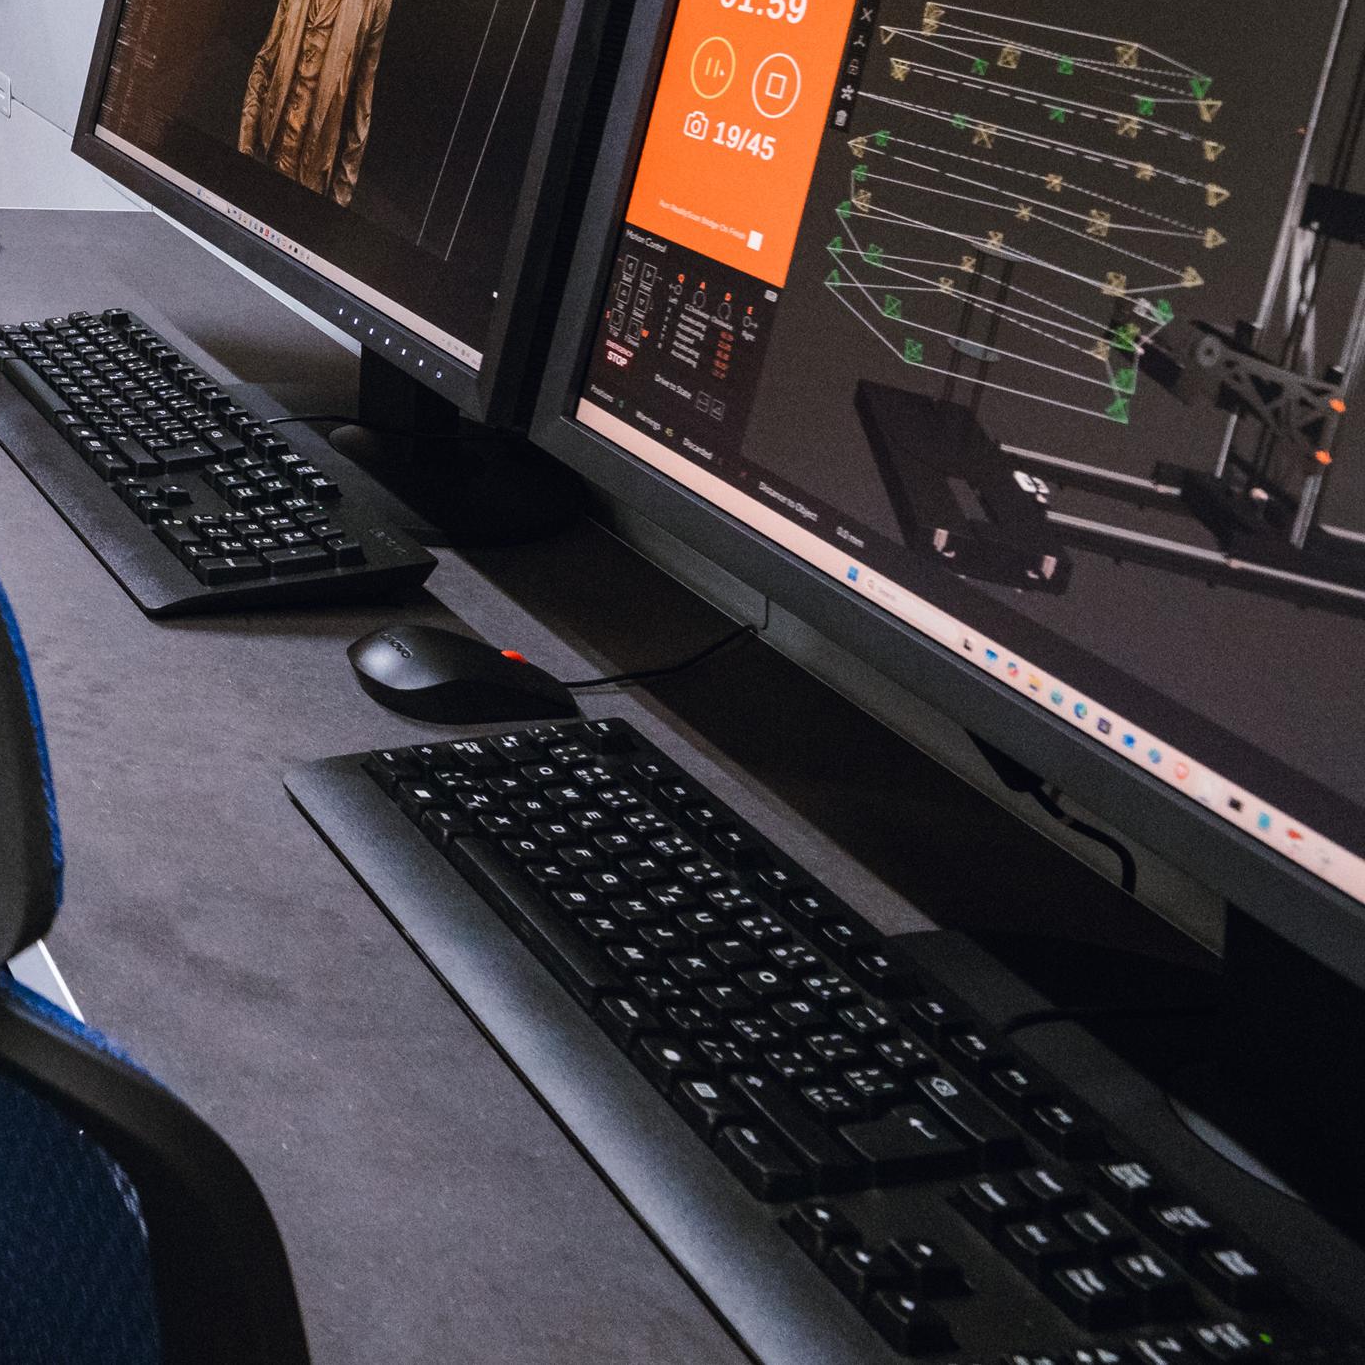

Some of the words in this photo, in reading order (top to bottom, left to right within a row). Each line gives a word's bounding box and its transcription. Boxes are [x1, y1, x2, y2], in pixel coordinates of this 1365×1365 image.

[712, 121, 777, 161] 19/45
[626, 229, 646, 245] Motion
[645, 238, 667, 253] Control
[606, 350, 628, 367] STOP
[758, 481, 789, 506] Distance
[787, 498, 796, 509] to
[794, 501, 818, 523] Object
[562, 788, 579, 799] W
[527, 801, 541, 809] S
[494, 816, 511, 824] X
[585, 811, 602, 819] E
[550, 825, 566, 833] D
[611, 834, 628, 845] R
[520, 840, 535, 851] C
[575, 848, 592, 858] F
[639, 858, 655, 868] T
[544, 866, 561, 876] V
[602, 874, 618, 884] G
[668, 886, 683, 894] Y
[569, 892, 586, 902] B
[658, 894, 676, 905] Z
[628, 900, 647, 912] H
[695, 912, 713, 923] U
[595, 918, 615, 930] N
[656, 928, 674, 937] J
[623, 946, 645, 959] M
[687, 957, 707, 968] K
[758, 971, 777, 984] O
[717, 987, 732, 997] L
[790, 1001, 810, 1013] P
